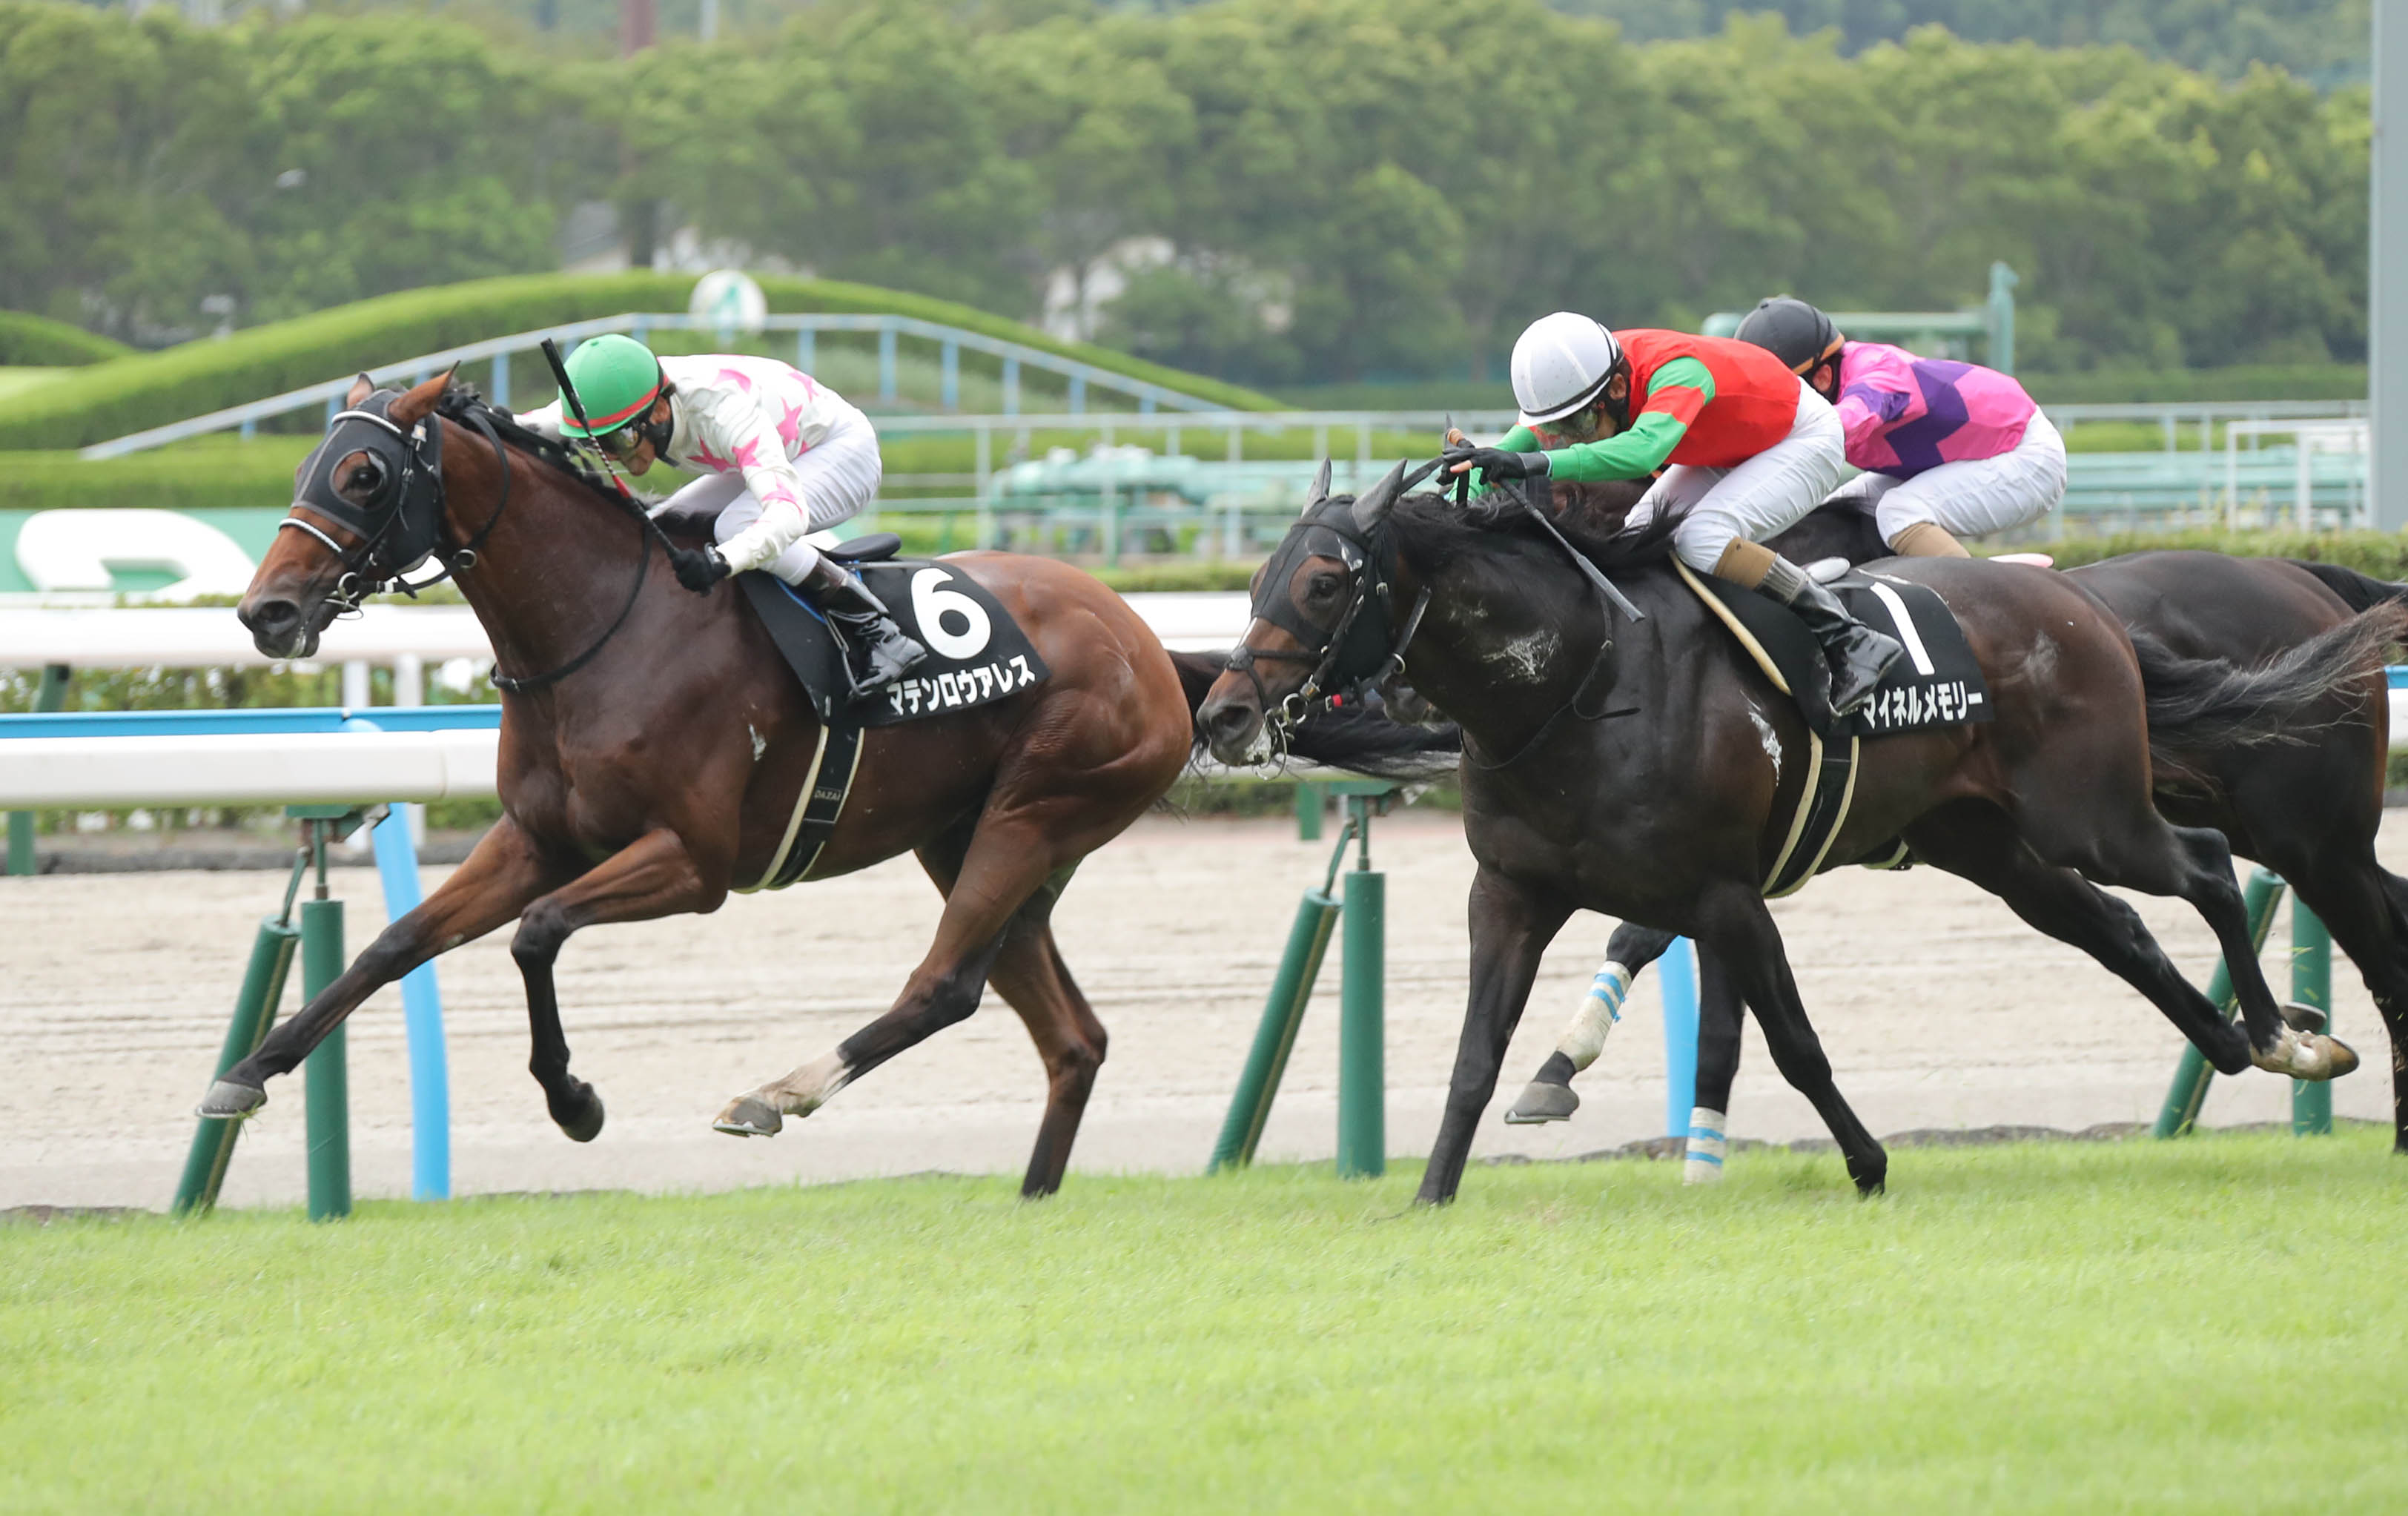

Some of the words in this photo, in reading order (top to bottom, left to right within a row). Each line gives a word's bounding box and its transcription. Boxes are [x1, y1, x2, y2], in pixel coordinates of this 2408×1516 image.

[911, 568, 991, 659] 6
[1870, 582, 1935, 675] 1
[887, 655, 1036, 715] マテンロウアレス
[1862, 681, 1983, 729] マイネルメモリー
